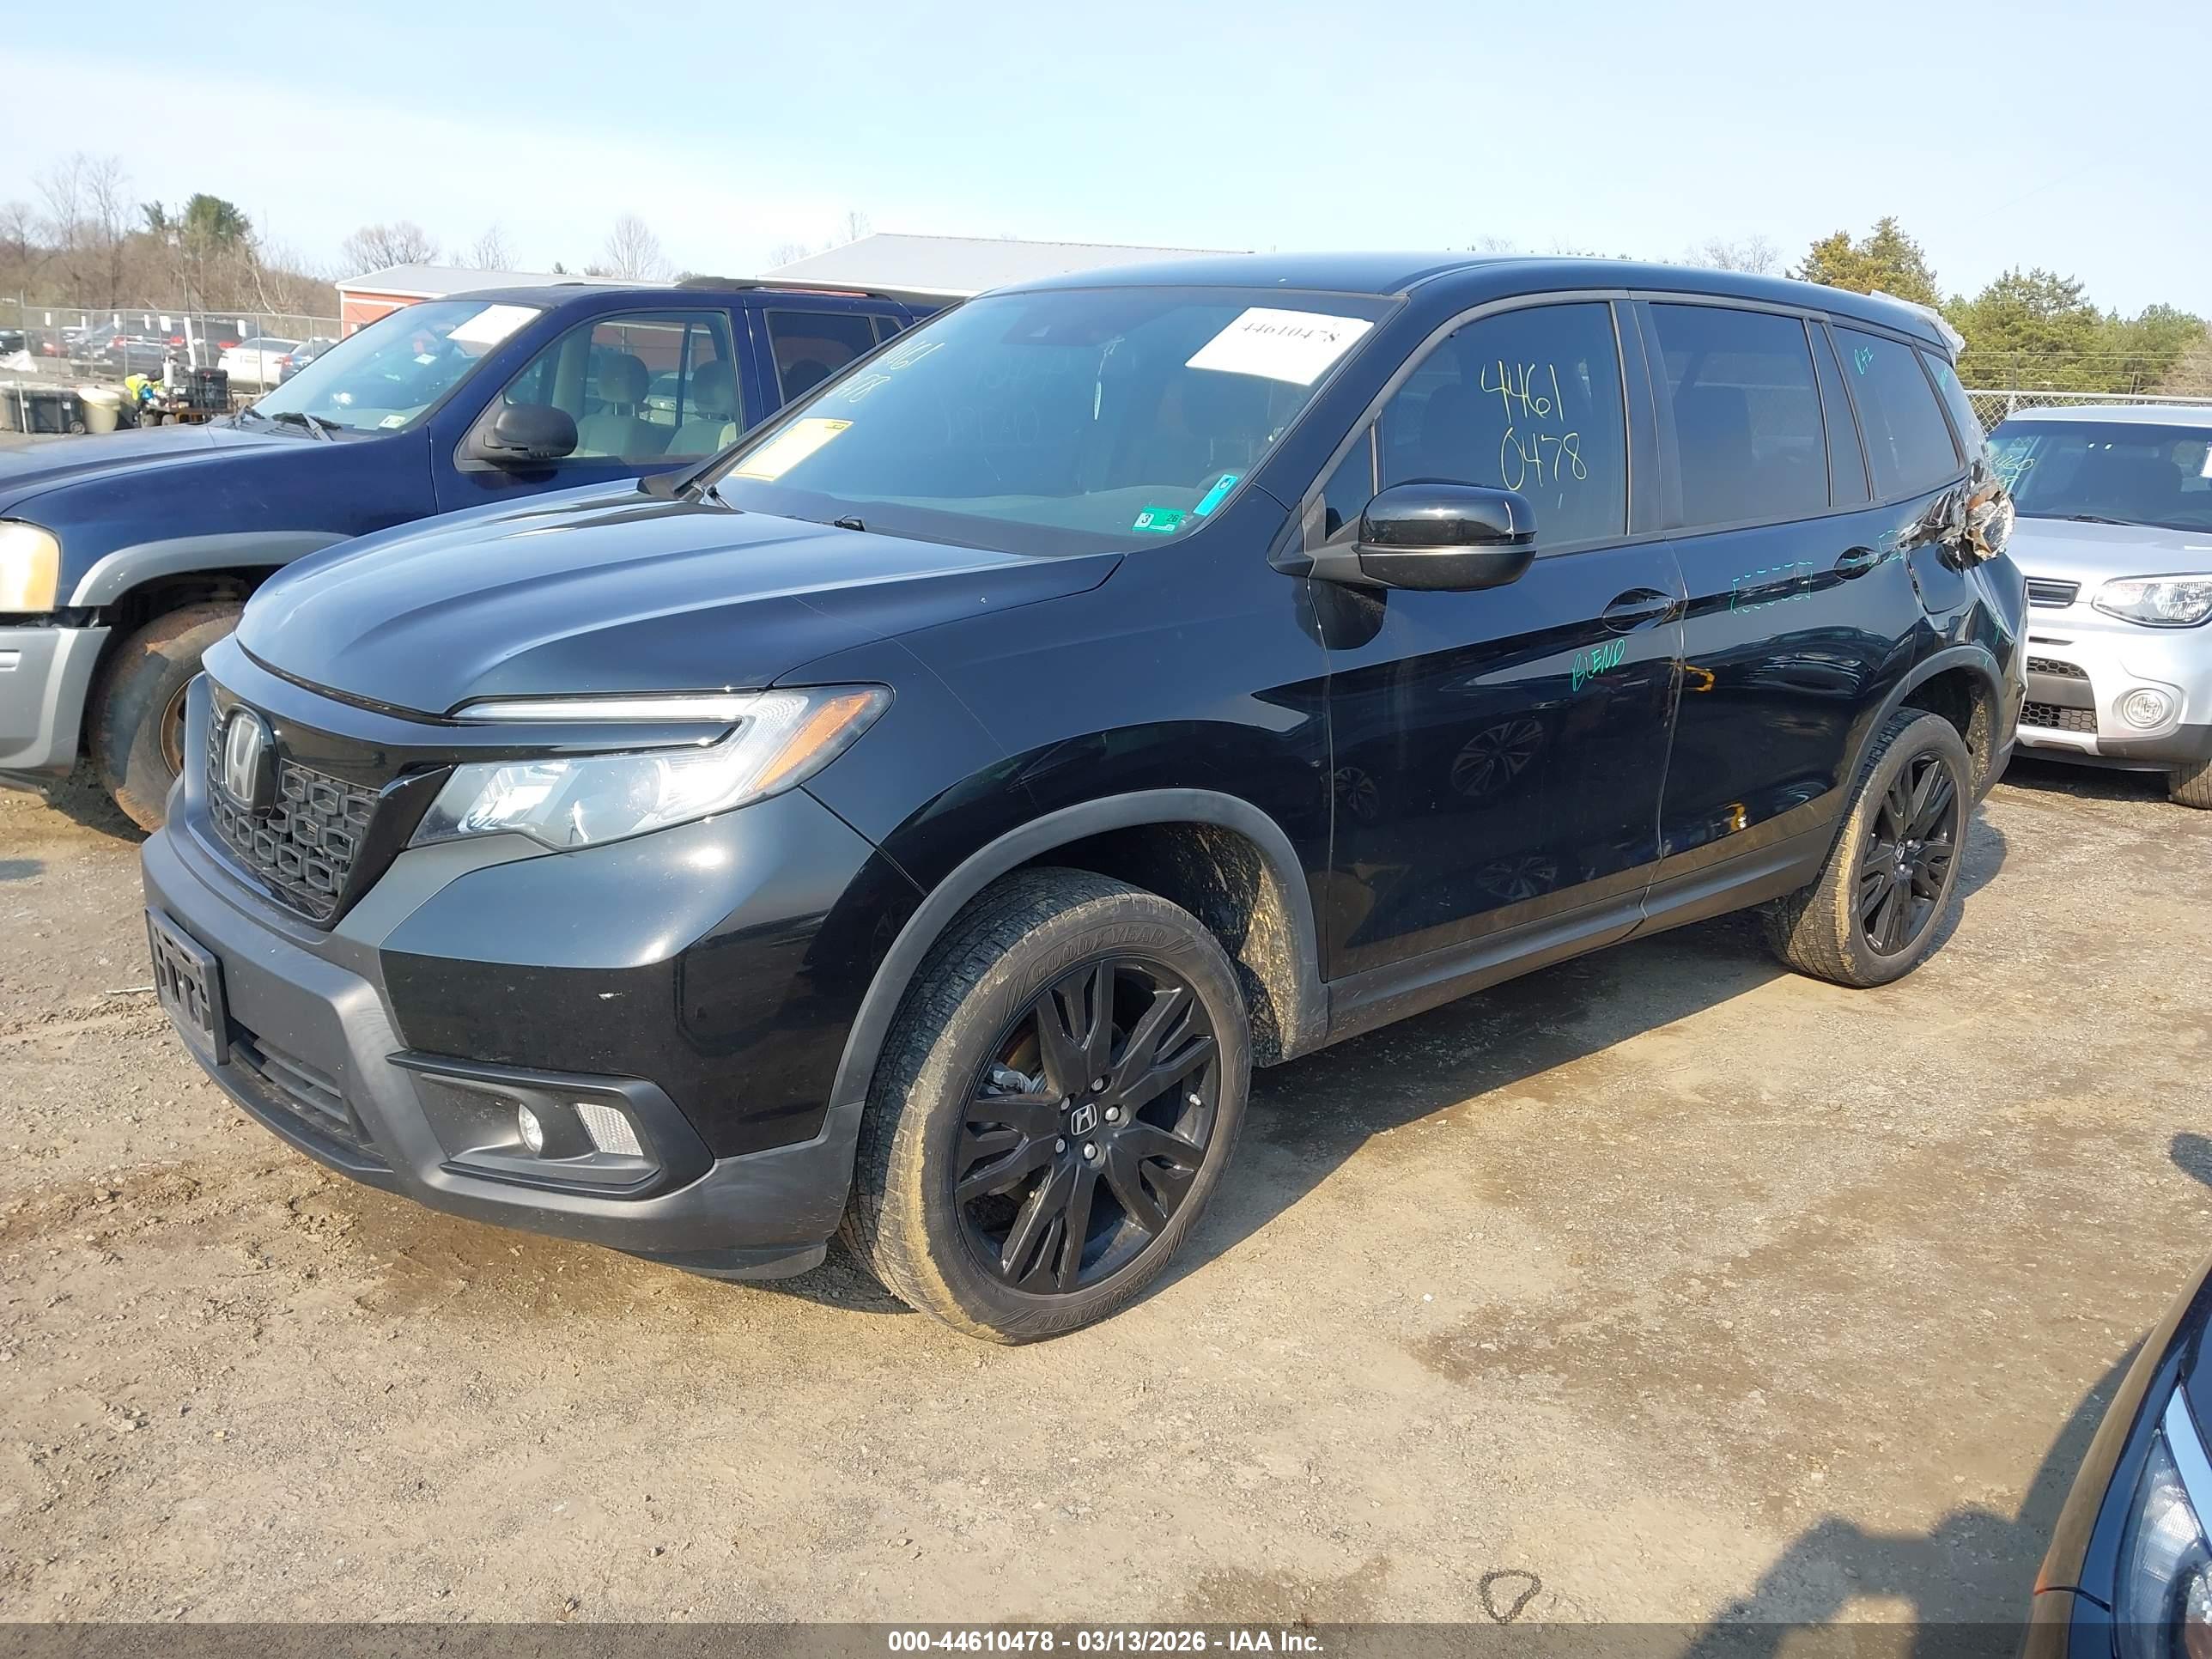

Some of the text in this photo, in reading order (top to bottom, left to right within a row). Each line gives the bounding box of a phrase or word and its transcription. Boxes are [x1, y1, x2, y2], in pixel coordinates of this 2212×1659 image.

[1480, 360, 1565, 424] 4461
[1501, 427, 1587, 491] 0478
[1166, 514, 1181, 523] 26
[1571, 639, 1626, 692] BLEND
